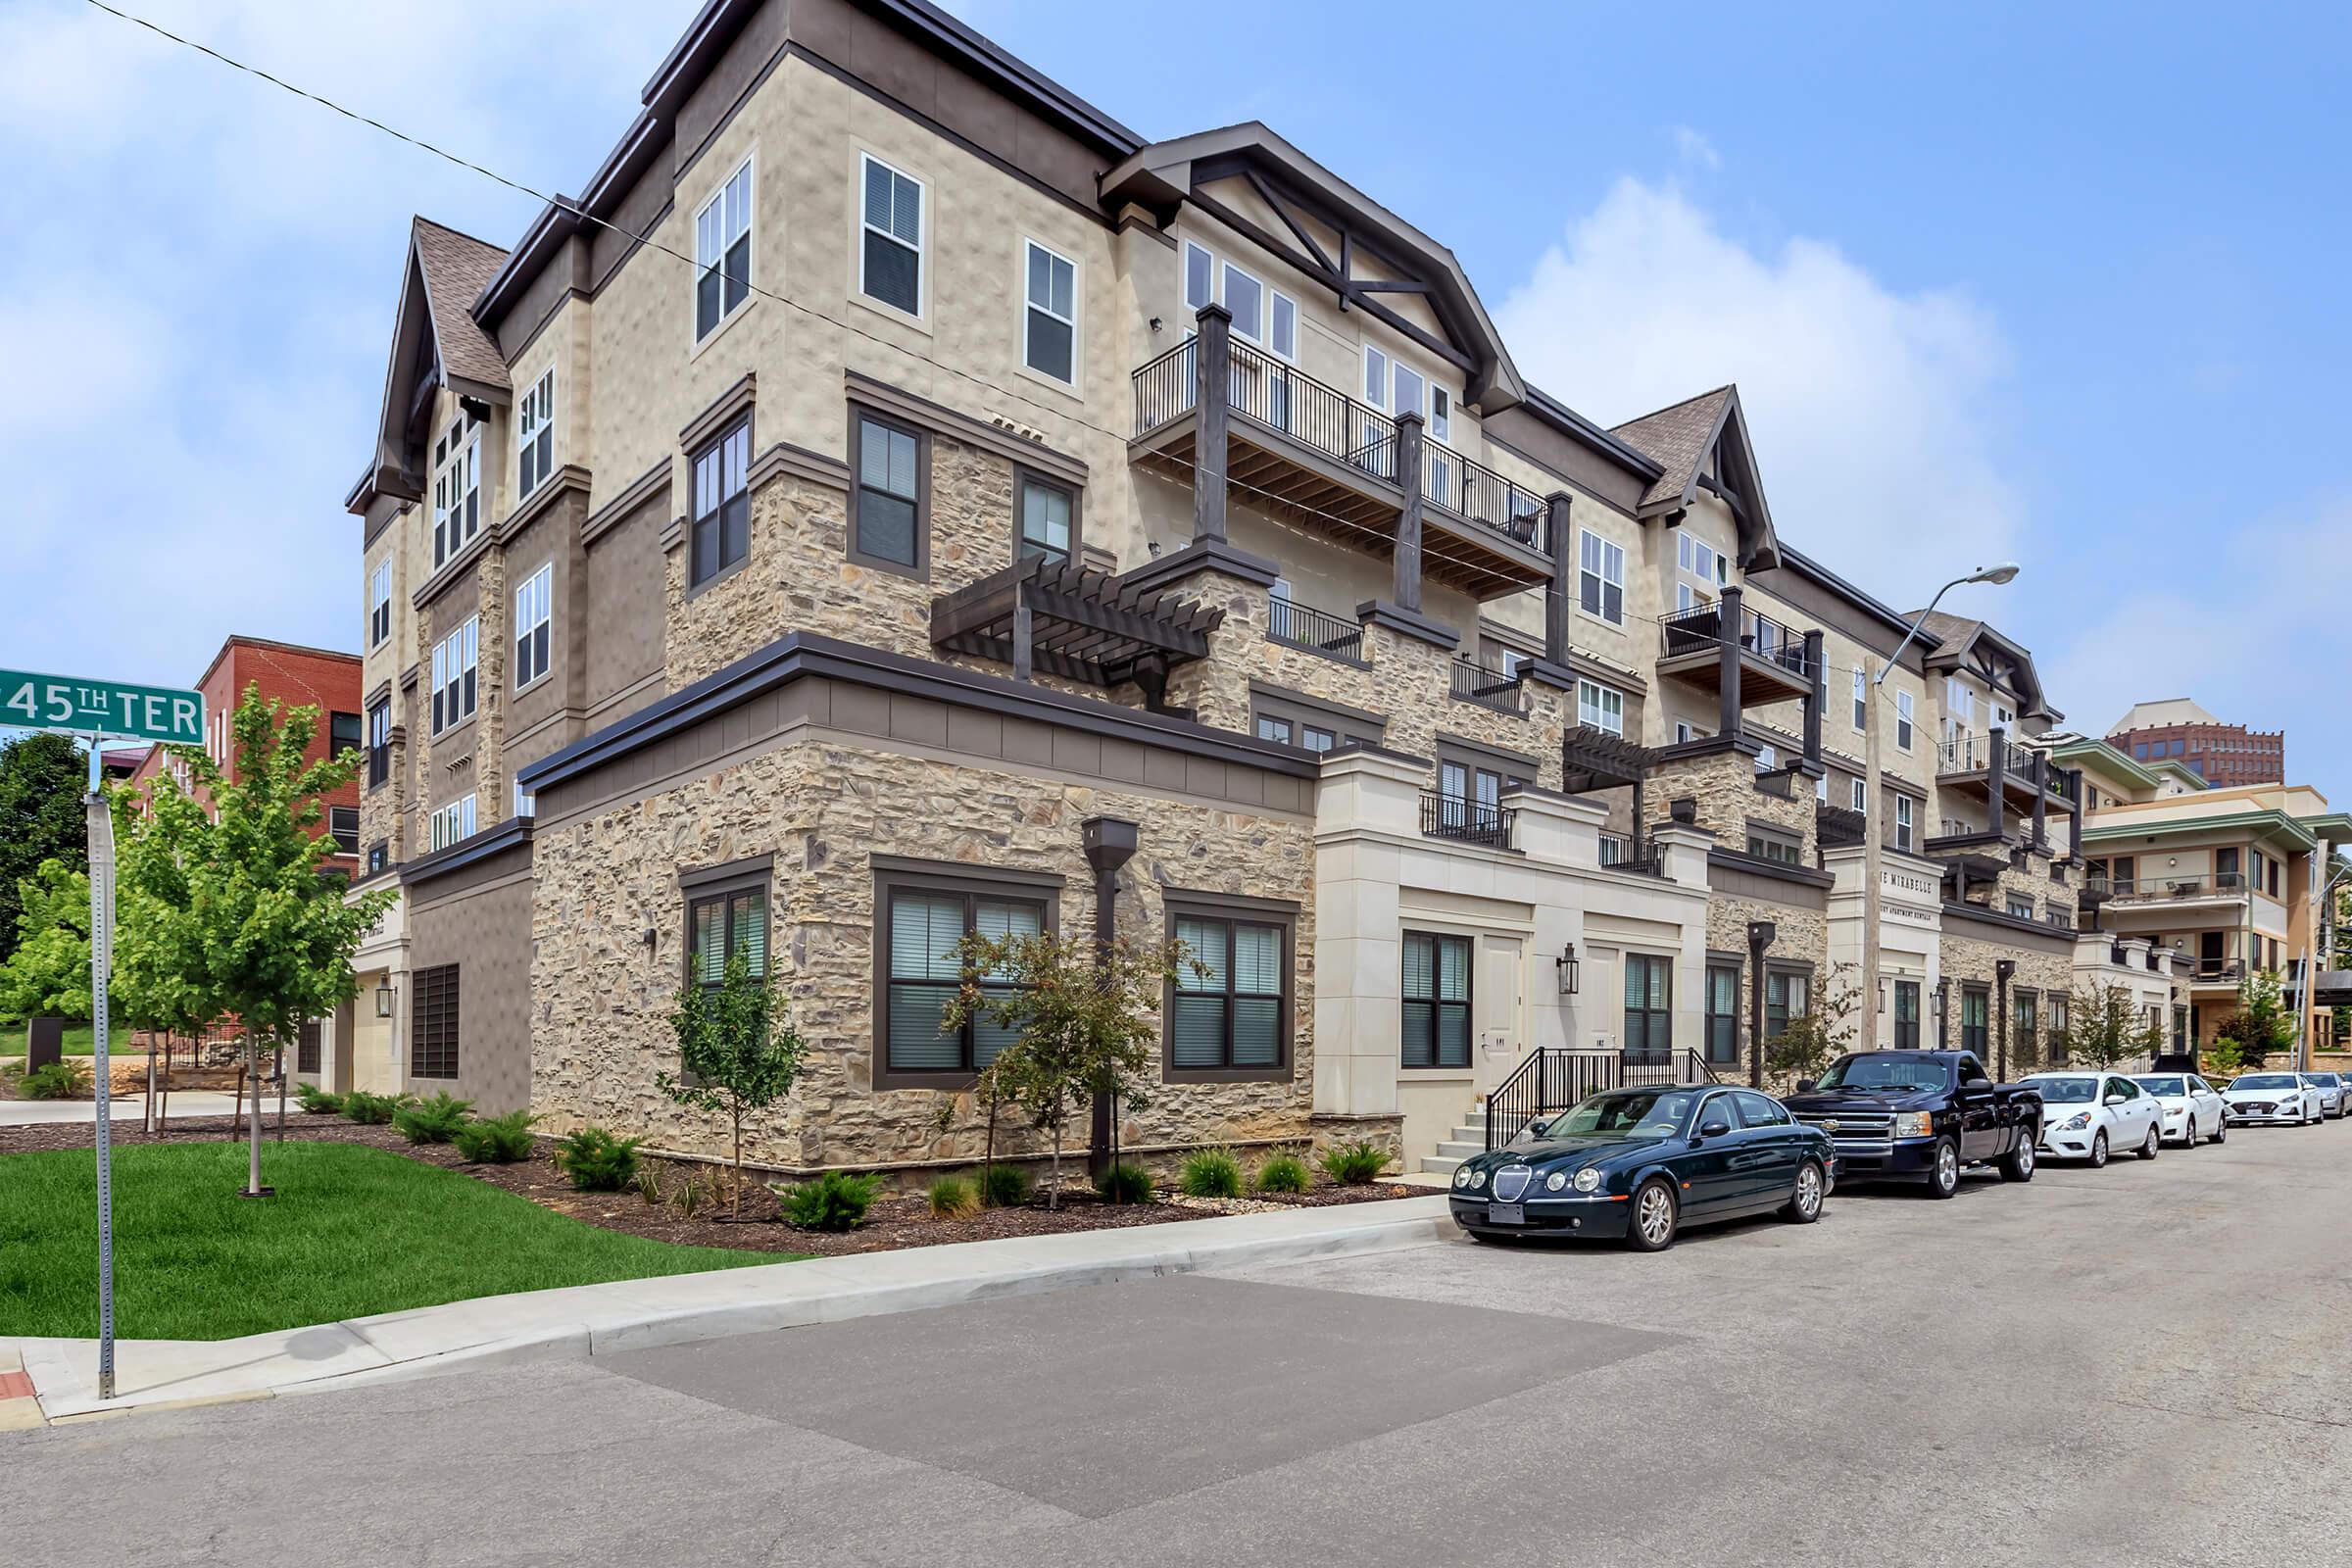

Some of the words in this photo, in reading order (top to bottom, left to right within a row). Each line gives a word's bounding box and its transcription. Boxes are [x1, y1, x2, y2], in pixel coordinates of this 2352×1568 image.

[7, 682, 110, 721] 45TH
[116, 691, 197, 735] TER
[1890, 873, 1932, 894] MIRABELLE
[1889, 907, 1913, 917] APARTMENT
